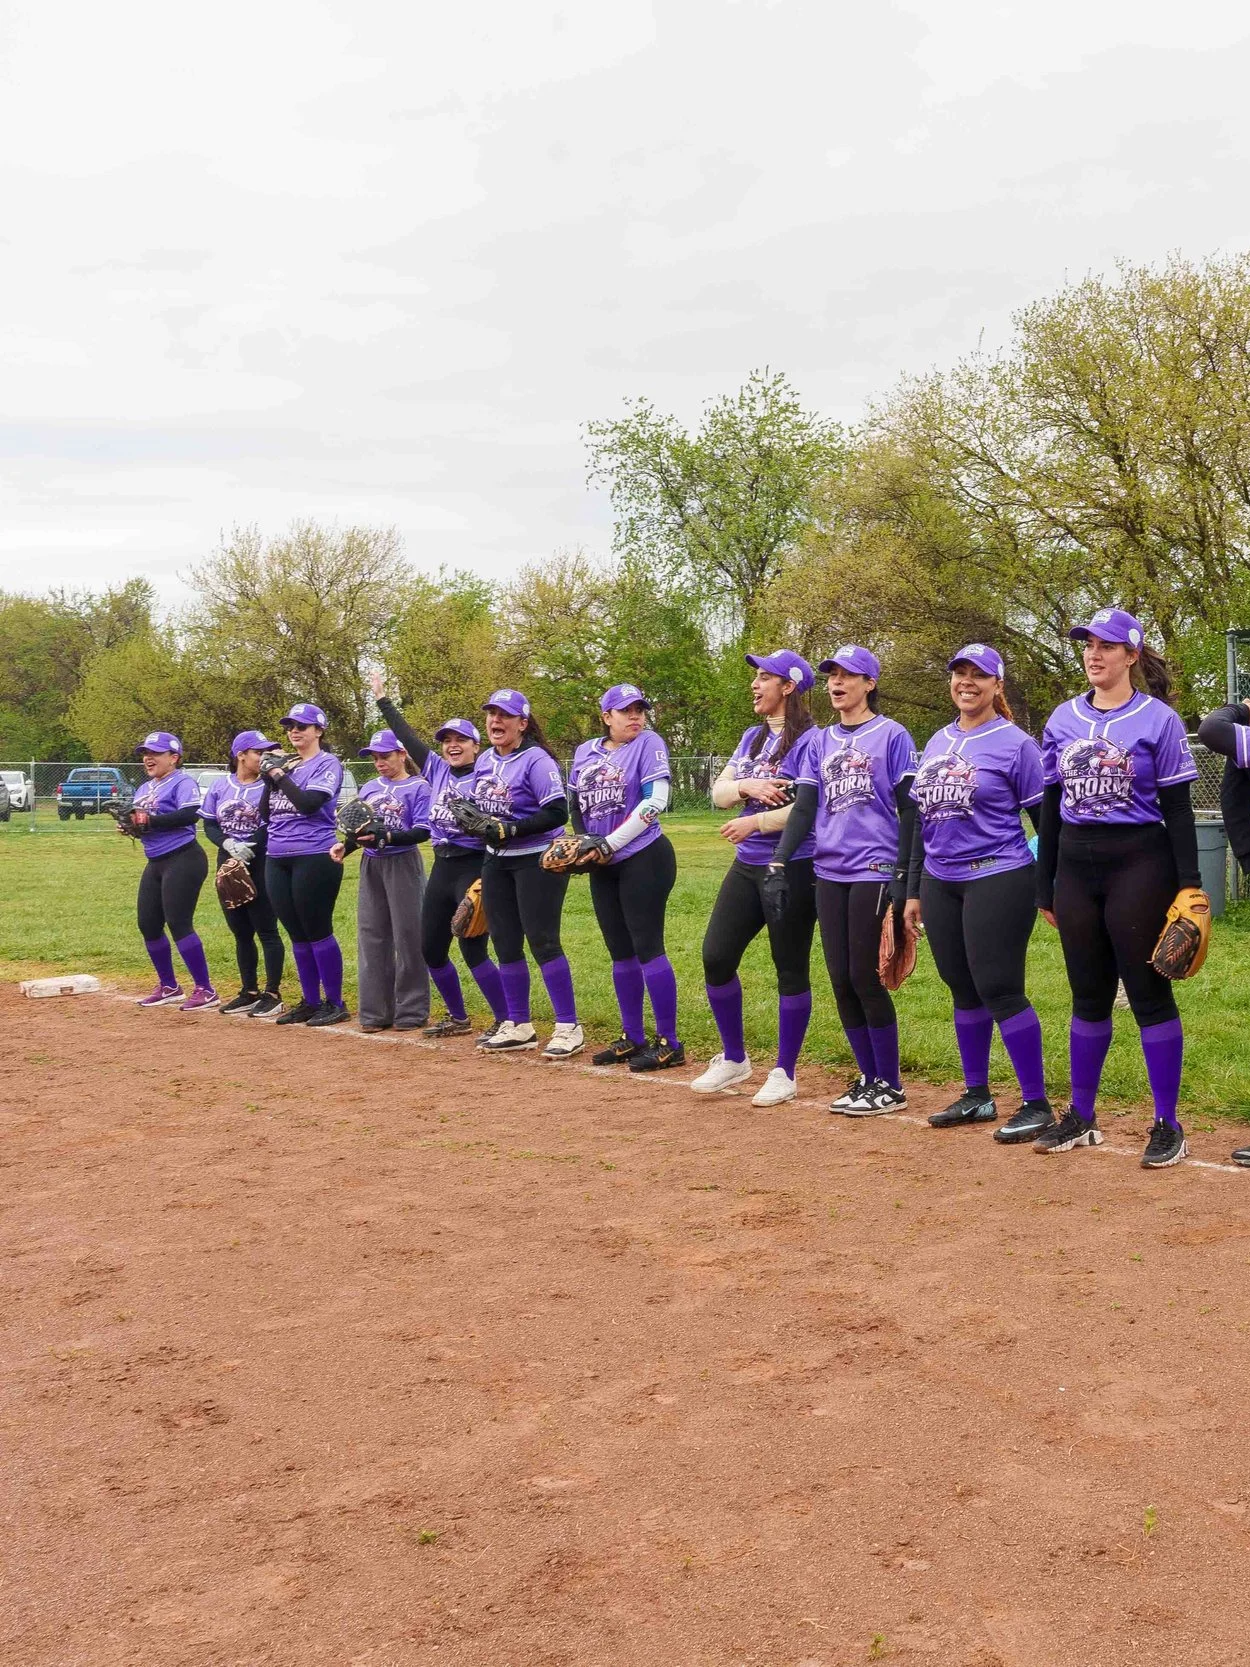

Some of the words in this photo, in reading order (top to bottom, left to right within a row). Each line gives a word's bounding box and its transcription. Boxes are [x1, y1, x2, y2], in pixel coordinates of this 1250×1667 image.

[1064, 769, 1079, 778] THE
[579, 786, 624, 814] STORM
[916, 785, 976, 815] STORM
[1063, 776, 1134, 809] STORM
[475, 799, 512, 815] TORM
